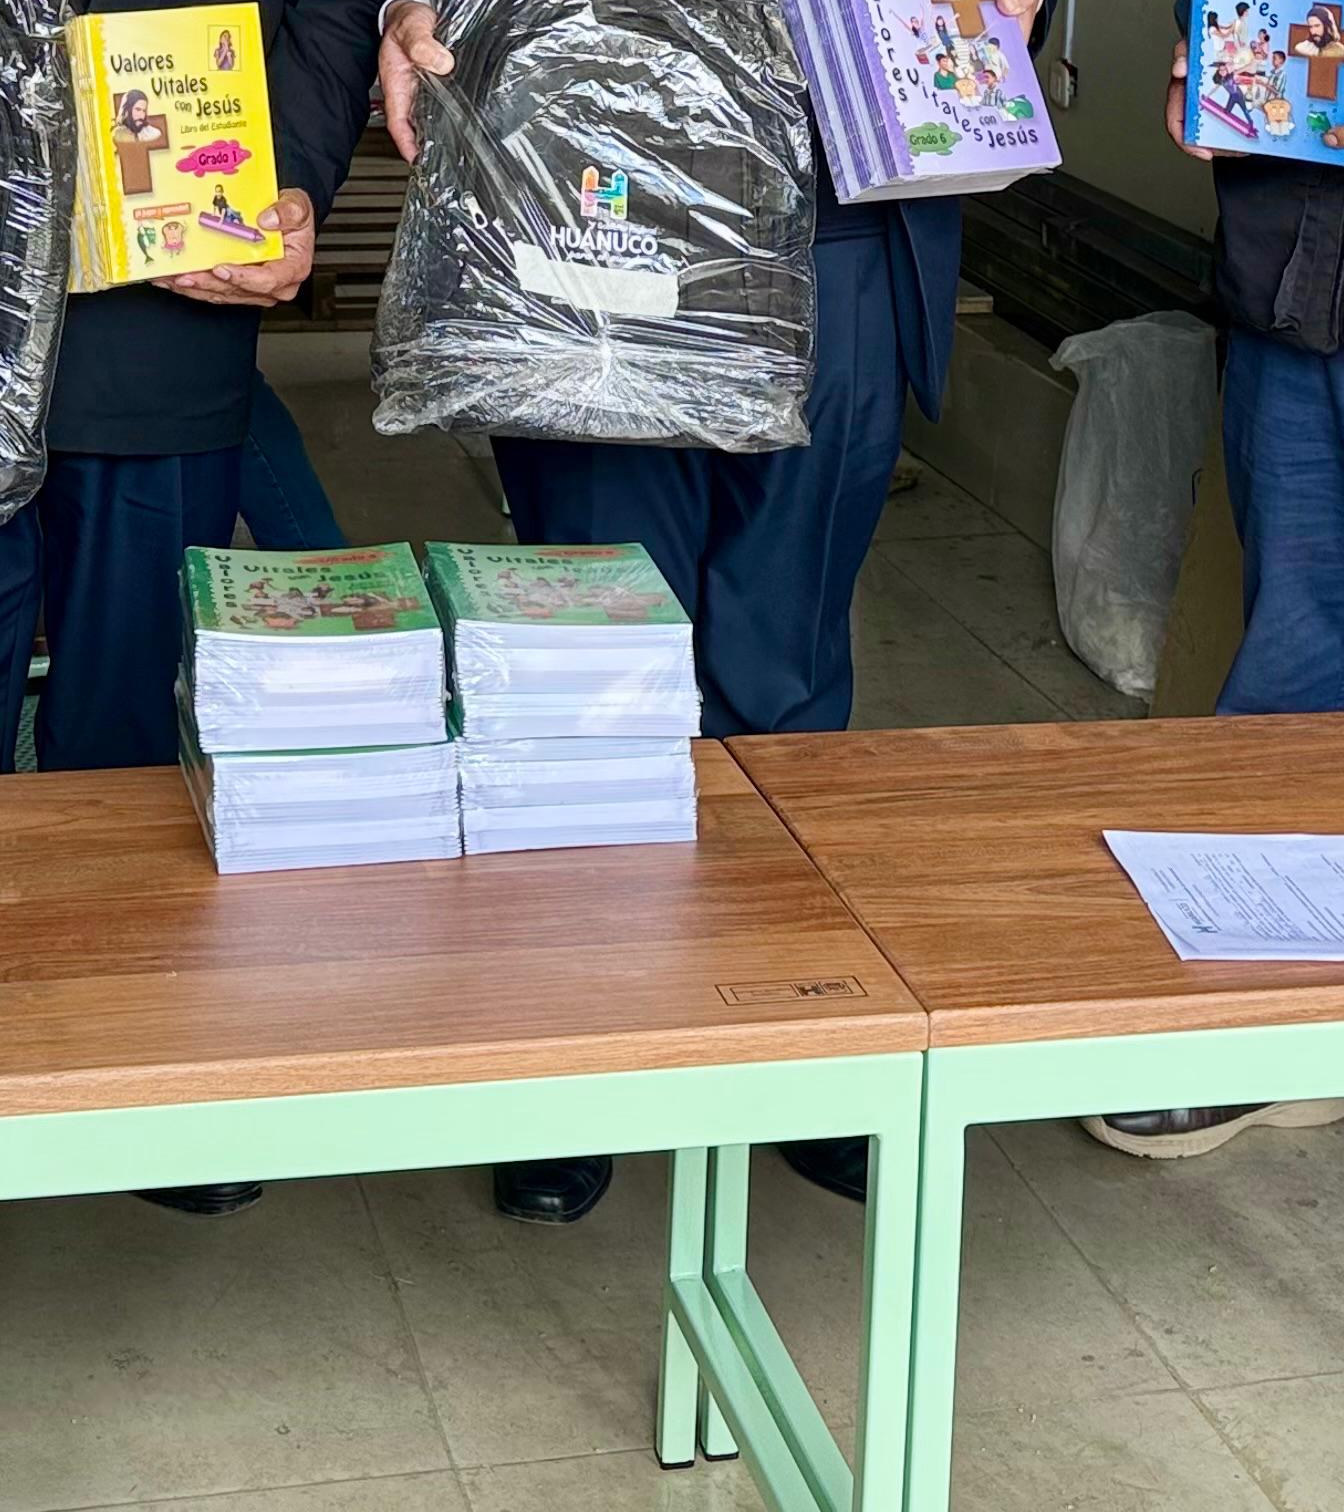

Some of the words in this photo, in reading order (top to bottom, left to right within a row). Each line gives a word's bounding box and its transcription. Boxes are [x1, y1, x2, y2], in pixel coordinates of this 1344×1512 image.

[110, 52, 174, 74] Valores
[150, 75, 208, 96] Vitales
[175, 100, 192, 112] con
[196, 94, 241, 116] Jesús
[979, 115, 997, 126] con
[909, 133, 938, 145] Grado
[988, 125, 1038, 148] Jesús
[198, 152, 229, 166] Grado
[232, 150, 237, 162] 1
[486, 556, 573, 565] Vitales
[243, 564, 333, 574] Vitales
